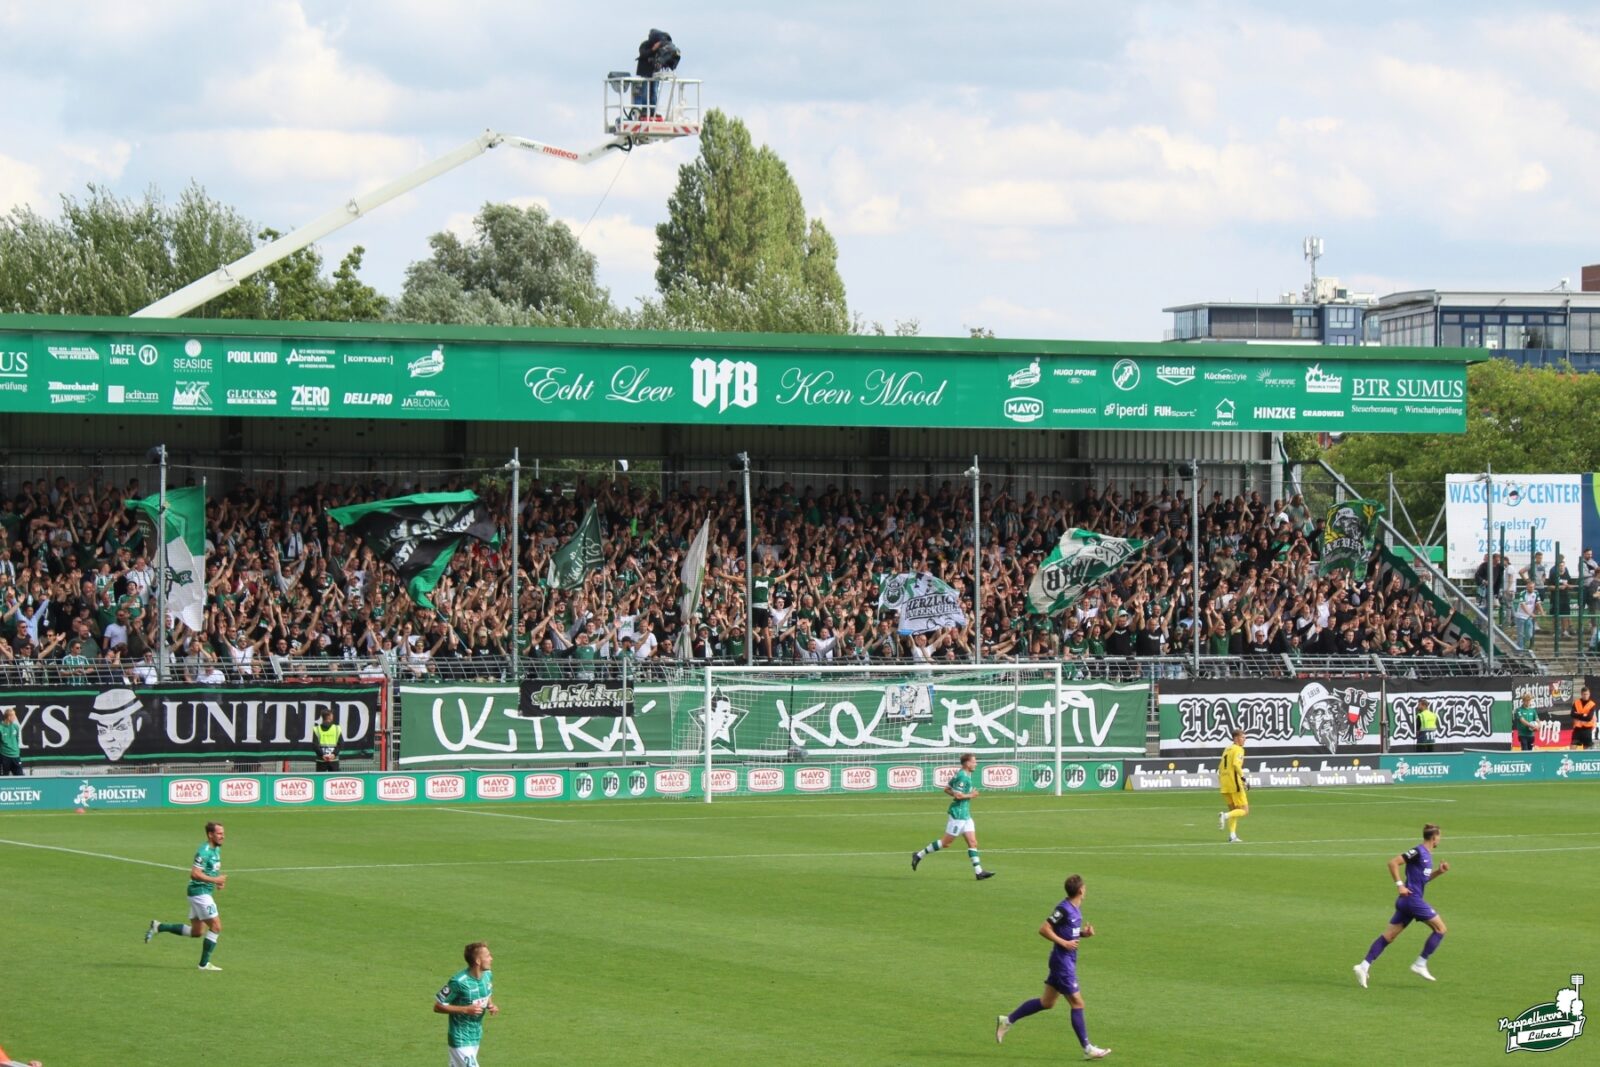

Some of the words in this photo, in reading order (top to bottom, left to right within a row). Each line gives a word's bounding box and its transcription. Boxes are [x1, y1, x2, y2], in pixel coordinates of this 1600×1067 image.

[543, 146, 578, 160] mateco
[110, 344, 136, 355] TAFEL
[173, 358, 213, 369] SEASIDE
[1156, 365, 1196, 375] clement
[1204, 372, 1247, 382] Küchenstyle
[524, 366, 594, 404] Echt
[605, 365, 675, 404] Leev
[690, 357, 758, 414] VfB
[776, 367, 854, 406] Keen
[860, 369, 948, 407] Mood
[1352, 378, 1391, 396] BTR
[1396, 379, 1464, 398] SUMUS
[125, 389, 159, 400] aditum
[343, 393, 393, 405] DELLPRO
[401, 398, 450, 408] JABLONKA
[1008, 403, 1040, 413] MAYO
[1116, 403, 1148, 419] iperdi
[1254, 407, 1296, 419] HINZKE
[1352, 405, 1398, 415] Steuerberatung
[1404, 405, 1463, 416] Wirtschaftsprüfung
[1449, 483, 1500, 503] WASCH
[1528, 483, 1580, 503] CENTER
[1534, 517, 1547, 530] 97
[162, 700, 370, 745] UNITED
[1224, 754, 1228, 769] 1
[894, 769, 917, 777] MAYO
[988, 768, 1013, 776] MAYO
[1411, 765, 1450, 775] HOLSTEN
[1494, 763, 1532, 773] HOLSTEN
[754, 771, 778, 779] MAYO
[801, 770, 825, 778] MAYO
[847, 770, 871, 778] MAYO
[1033, 769, 1051, 783] VfB
[1065, 769, 1083, 783] VfB
[1097, 769, 1116, 782] VfB
[1270, 774, 1300, 785] bwin
[1317, 773, 1347, 784] bwin
[1356, 772, 1385, 783] bwin
[176, 783, 203, 791] MAYO
[227, 782, 253, 790] MAYO
[281, 781, 307, 789] MAYO
[331, 781, 357, 789] MAYO
[384, 780, 410, 788] MAYO
[432, 779, 458, 787] MAYO
[484, 778, 509, 786] MAYO
[531, 778, 557, 786] MAYO
[576, 777, 591, 791] VfB
[603, 776, 618, 790] VfB
[630, 775, 645, 789] VfB
[1140, 776, 1171, 788] bwin
[1181, 776, 1212, 787] bwin
[98, 788, 146, 800] HOLSTEN
